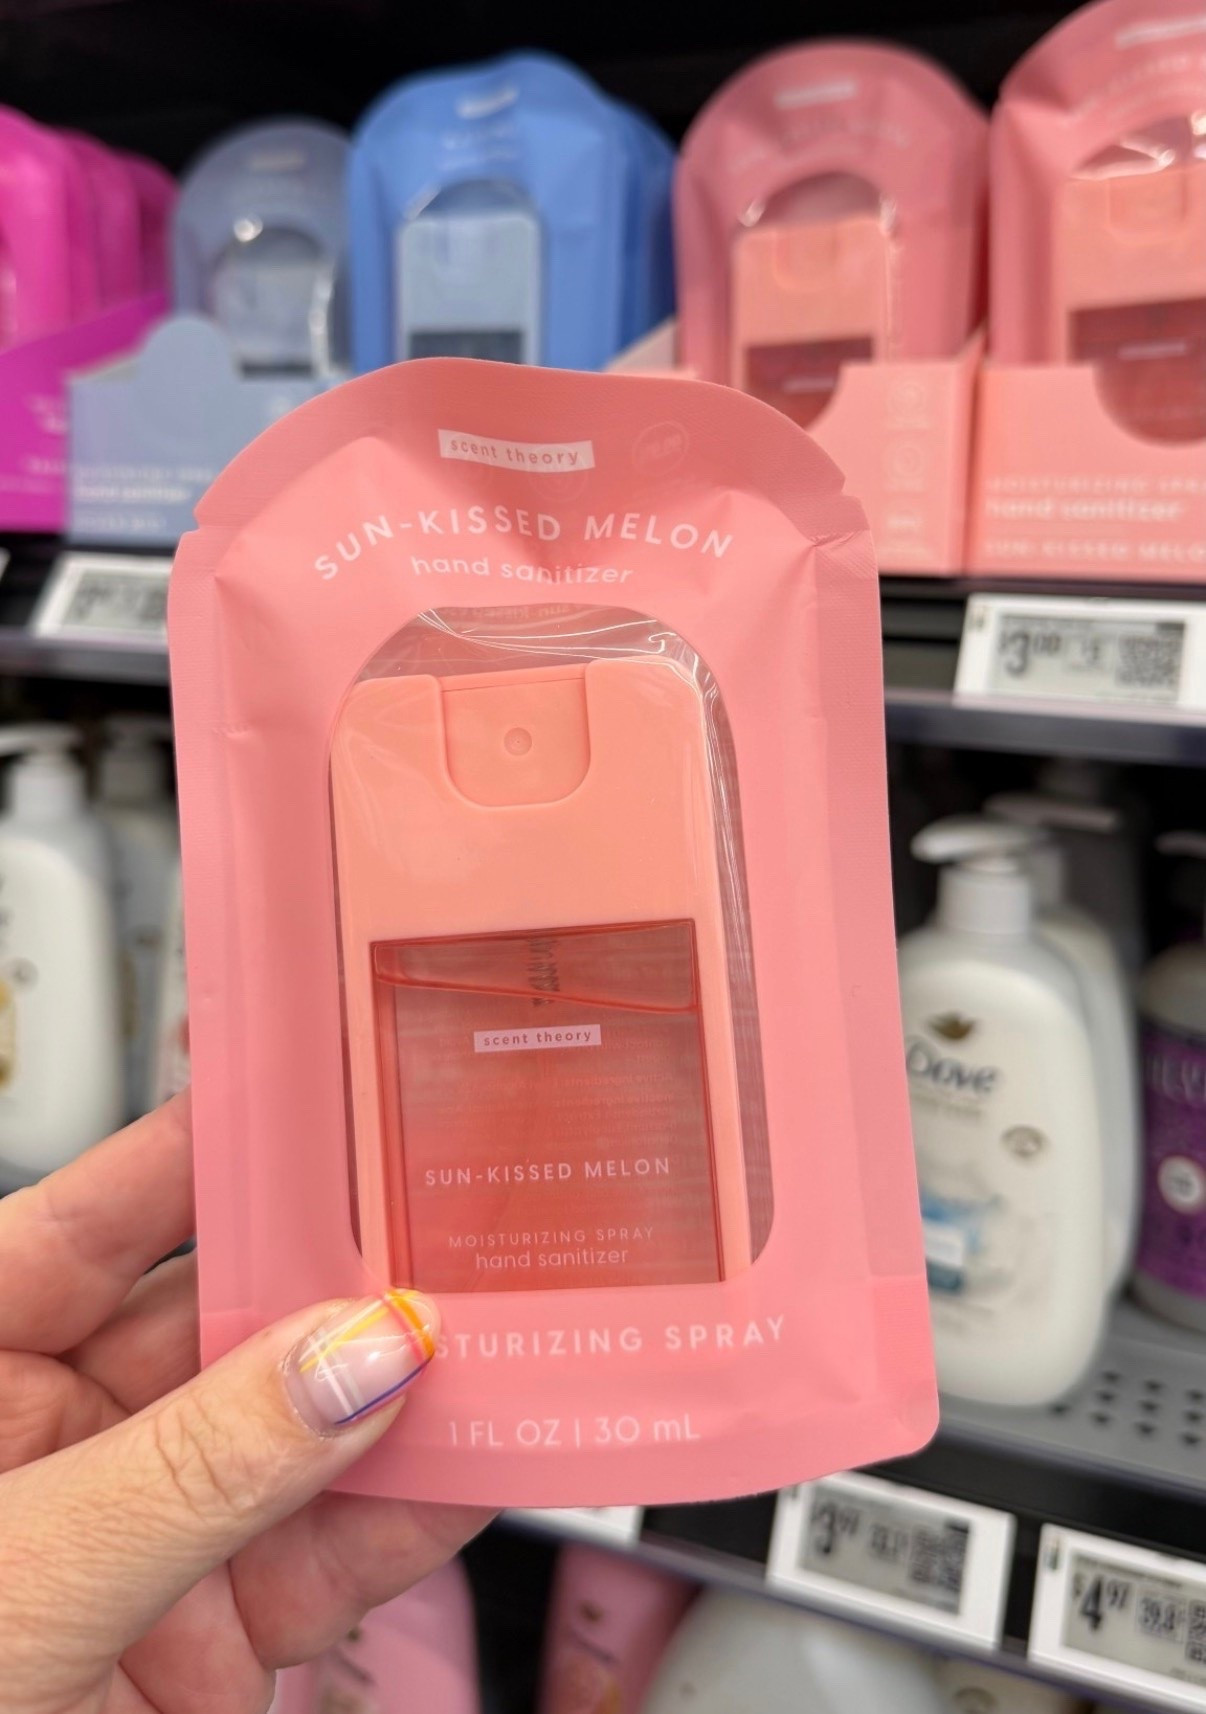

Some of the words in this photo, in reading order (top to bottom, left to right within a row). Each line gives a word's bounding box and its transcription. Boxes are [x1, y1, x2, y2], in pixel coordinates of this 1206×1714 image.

[451, 439, 497, 459] scent
[506, 448, 579, 466] theory
[314, 505, 561, 580] SUN-KISSED
[584, 512, 733, 558] MELON
[410, 555, 490, 576] hand
[501, 562, 634, 584] sanitizer
[483, 1033, 529, 1047] scent
[536, 1029, 593, 1044] theory
[906, 1035, 998, 1093] Dove
[424, 1161, 573, 1186] SUN-KISSED
[584, 1157, 671, 1178] MELON
[448, 1229, 587, 1248] MOISTURIZING
[596, 1226, 655, 1241] SPRAY
[475, 1250, 531, 1270] hand
[538, 1246, 629, 1267] sanitizer
[436, 1327, 643, 1359] STURIZING
[664, 1314, 785, 1351] SPRAY
[448, 1420, 459, 1446] 1
[470, 1420, 503, 1447] FL
[516, 1417, 562, 1446] OZ
[595, 1415, 640, 1444] 30
[654, 1412, 700, 1442] mL
